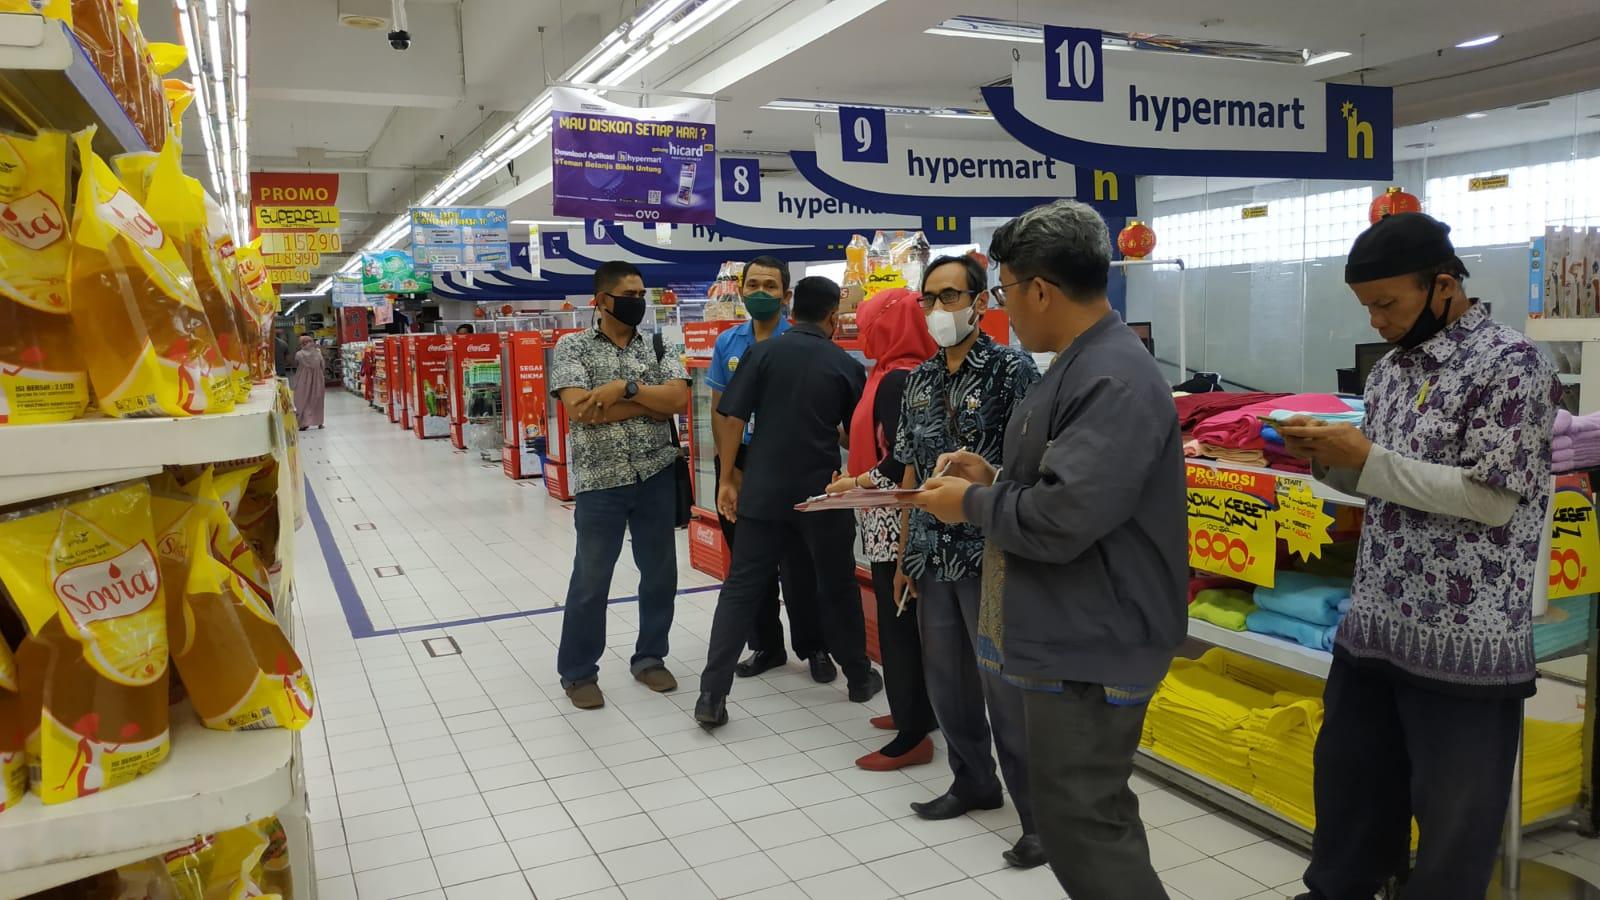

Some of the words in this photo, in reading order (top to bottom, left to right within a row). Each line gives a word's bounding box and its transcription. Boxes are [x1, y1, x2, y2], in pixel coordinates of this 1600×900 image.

[1055, 40, 1095, 89] 10
[1129, 84, 1305, 132] hypermart
[559, 116, 587, 131] MAU
[589, 118, 633, 135] DISKON
[635, 122, 674, 138] SETIAP
[675, 126, 698, 140] HARI
[700, 127, 708, 140] ?
[853, 116, 873, 153] 9
[627, 153, 662, 164] hypermart
[668, 141, 703, 158] hicard
[907, 149, 1057, 184] hypermart
[733, 165, 750, 196] 8
[260, 187, 329, 201] PROMO
[635, 209, 660, 220] OVO
[593, 219, 606, 240] 6
[282, 233, 340, 252] 15290
[466, 343, 491, 353] Coca-Cola
[1187, 466, 1256, 487] PROMOSI
[1195, 477, 1243, 491] KATALOG
[61, 569, 154, 615] Sovia
